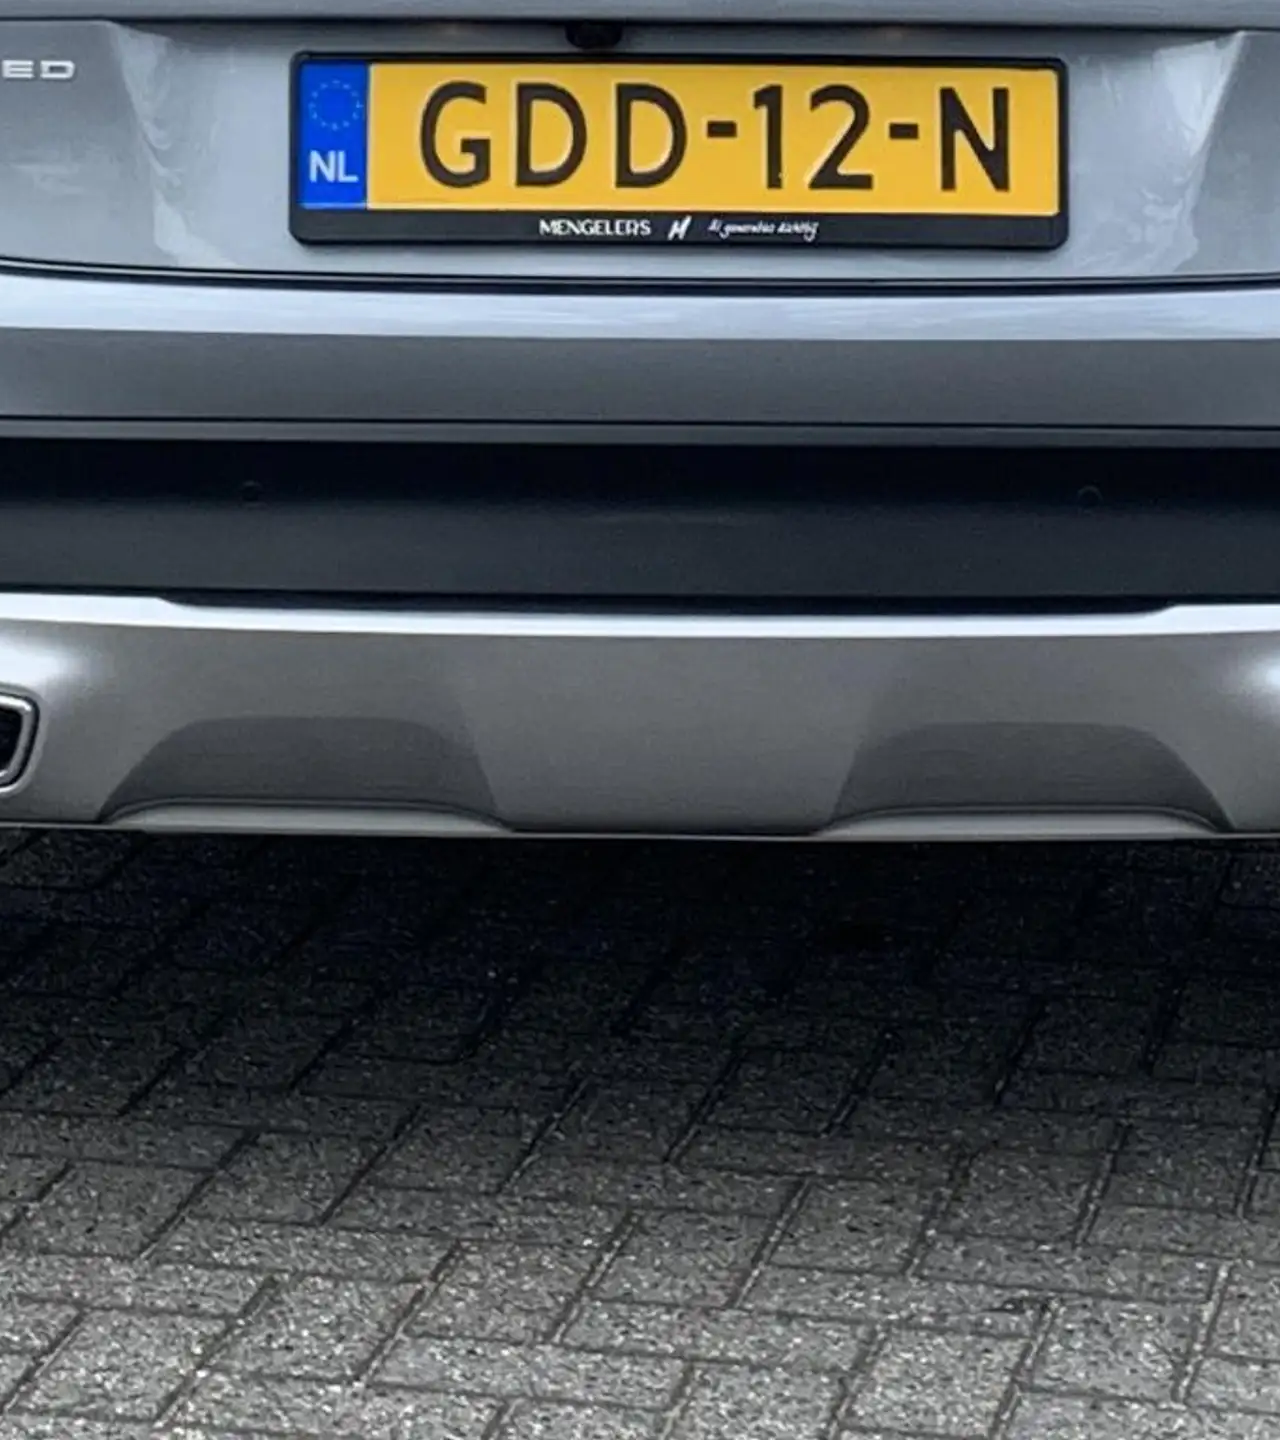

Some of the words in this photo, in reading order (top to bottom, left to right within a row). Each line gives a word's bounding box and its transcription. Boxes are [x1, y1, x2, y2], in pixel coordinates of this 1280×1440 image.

[308, 150, 358, 184] NL
[419, 80, 1011, 193] GDD-12-N
[538, 218, 652, 237] MENGELERS
